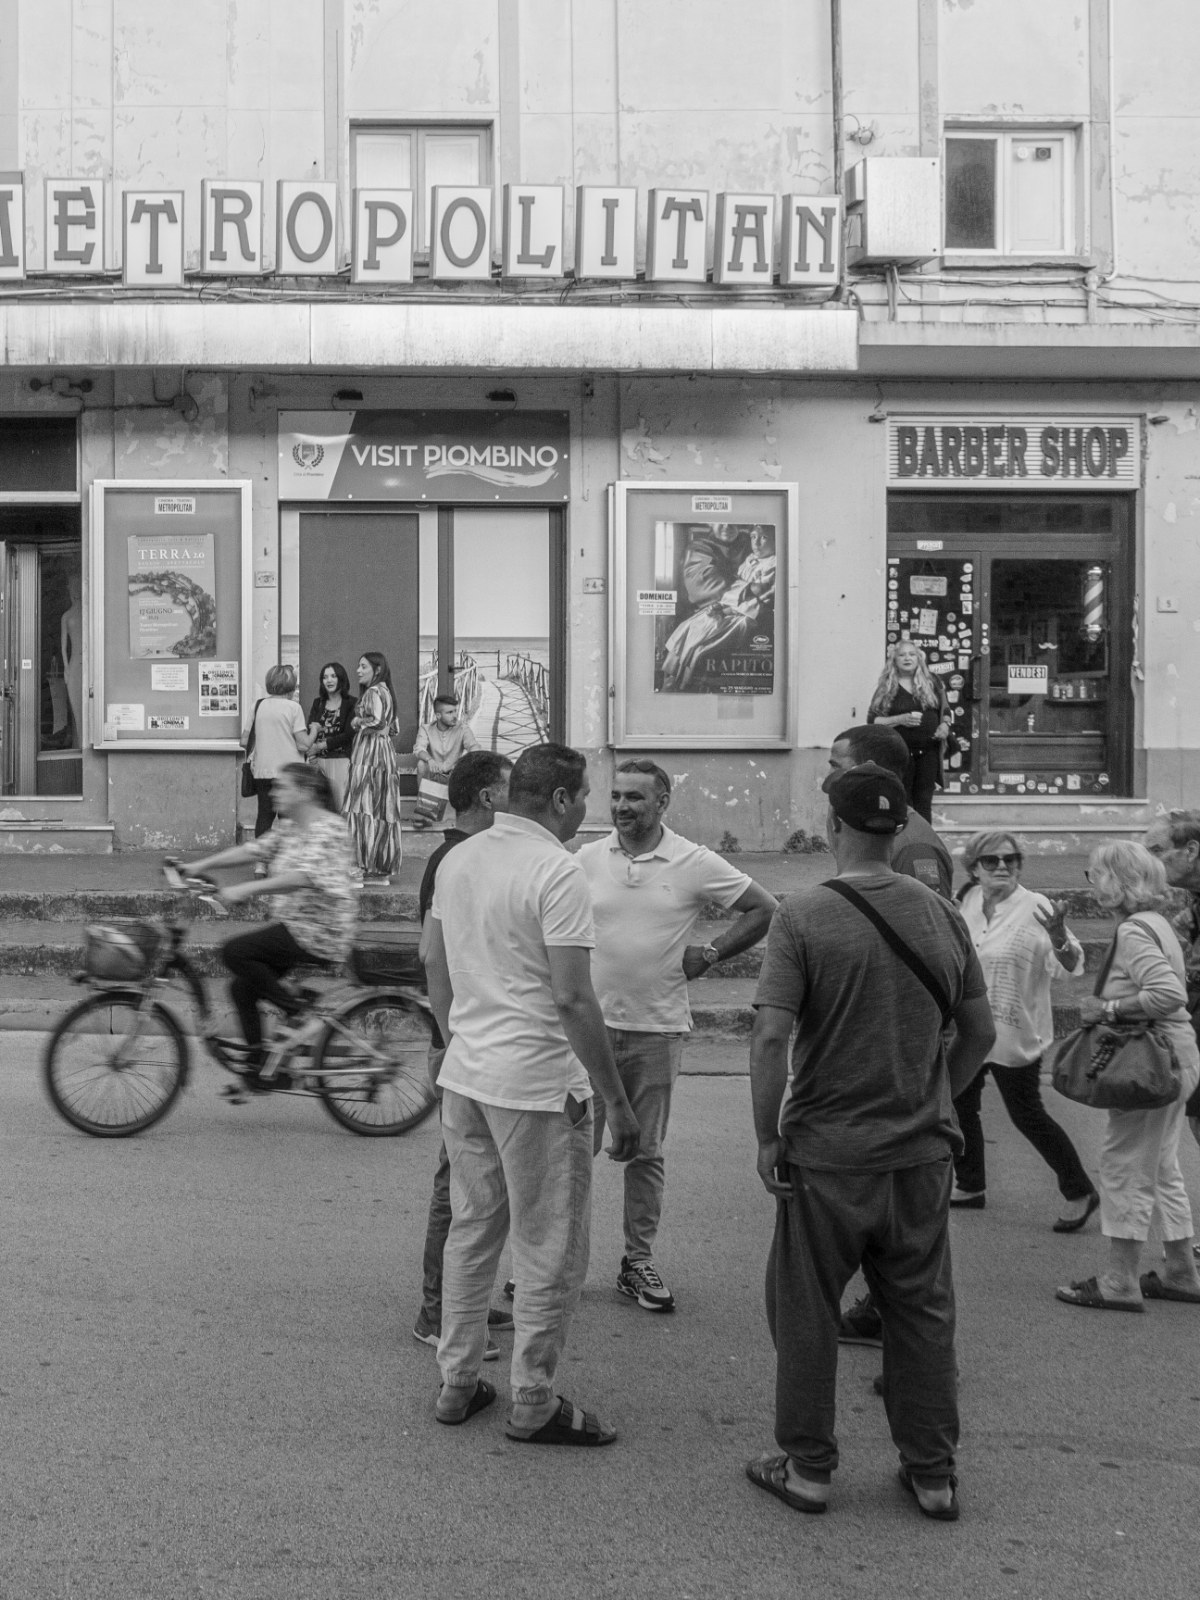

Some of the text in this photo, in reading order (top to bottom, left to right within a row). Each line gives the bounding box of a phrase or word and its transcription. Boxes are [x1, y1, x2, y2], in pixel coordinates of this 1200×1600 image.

[351, 445, 559, 467] VISIT PIOMBINO
[897, 425, 1129, 478] BARBER SHOP
[158, 503, 193, 512] METROPOLITAN
[138, 549, 191, 560] TERRA
[640, 593, 673, 601] DOMENICA
[706, 659, 773, 672] RAPITO
[1010, 667, 1046, 679] VENDESI
